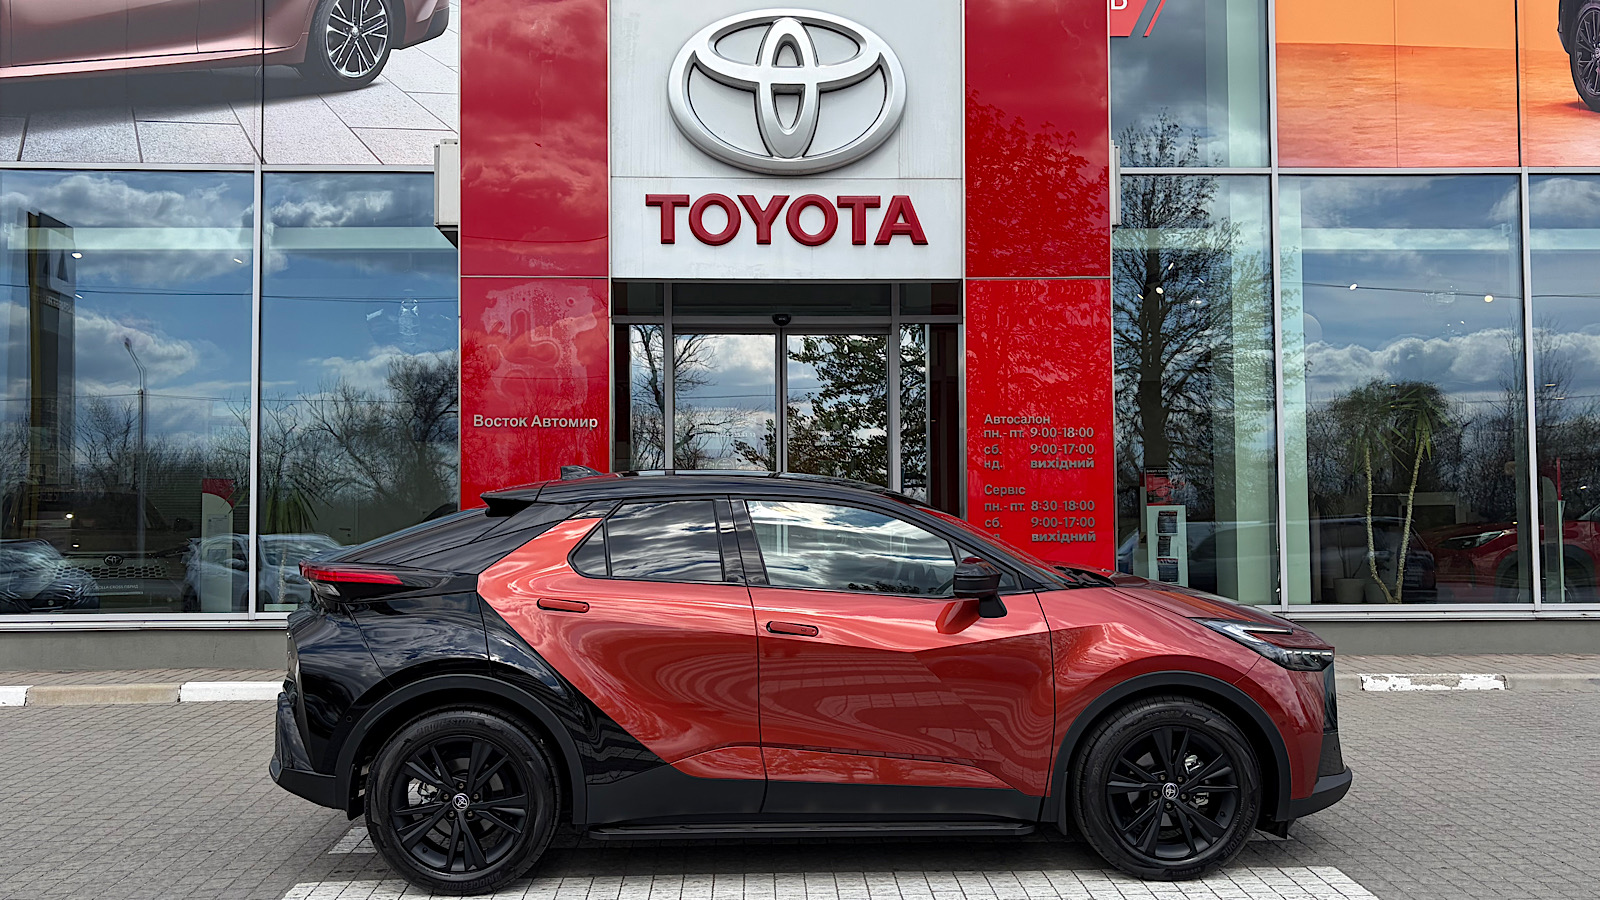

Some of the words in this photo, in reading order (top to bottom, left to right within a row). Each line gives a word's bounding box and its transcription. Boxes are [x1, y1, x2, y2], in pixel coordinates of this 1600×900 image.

[645, 193, 929, 246] TOYOTA
[473, 414, 528, 427] Восток
[530, 414, 598, 430] Автомир
[984, 414, 1051, 424] Автосалон
[1030, 427, 1094, 438] 9:00-18:00
[984, 443, 1002, 455] сб.
[1030, 443, 1095, 455] 9:00-17:00
[984, 460, 1003, 470] нд.
[1030, 457, 1095, 470] вихідний
[984, 484, 1026, 497] Сервіс
[1031, 500, 1095, 511] 8:30-18:00
[984, 517, 1003, 528] сб.
[1031, 517, 1096, 528] 9:00-17:00
[1031, 530, 1096, 543] вихідний
